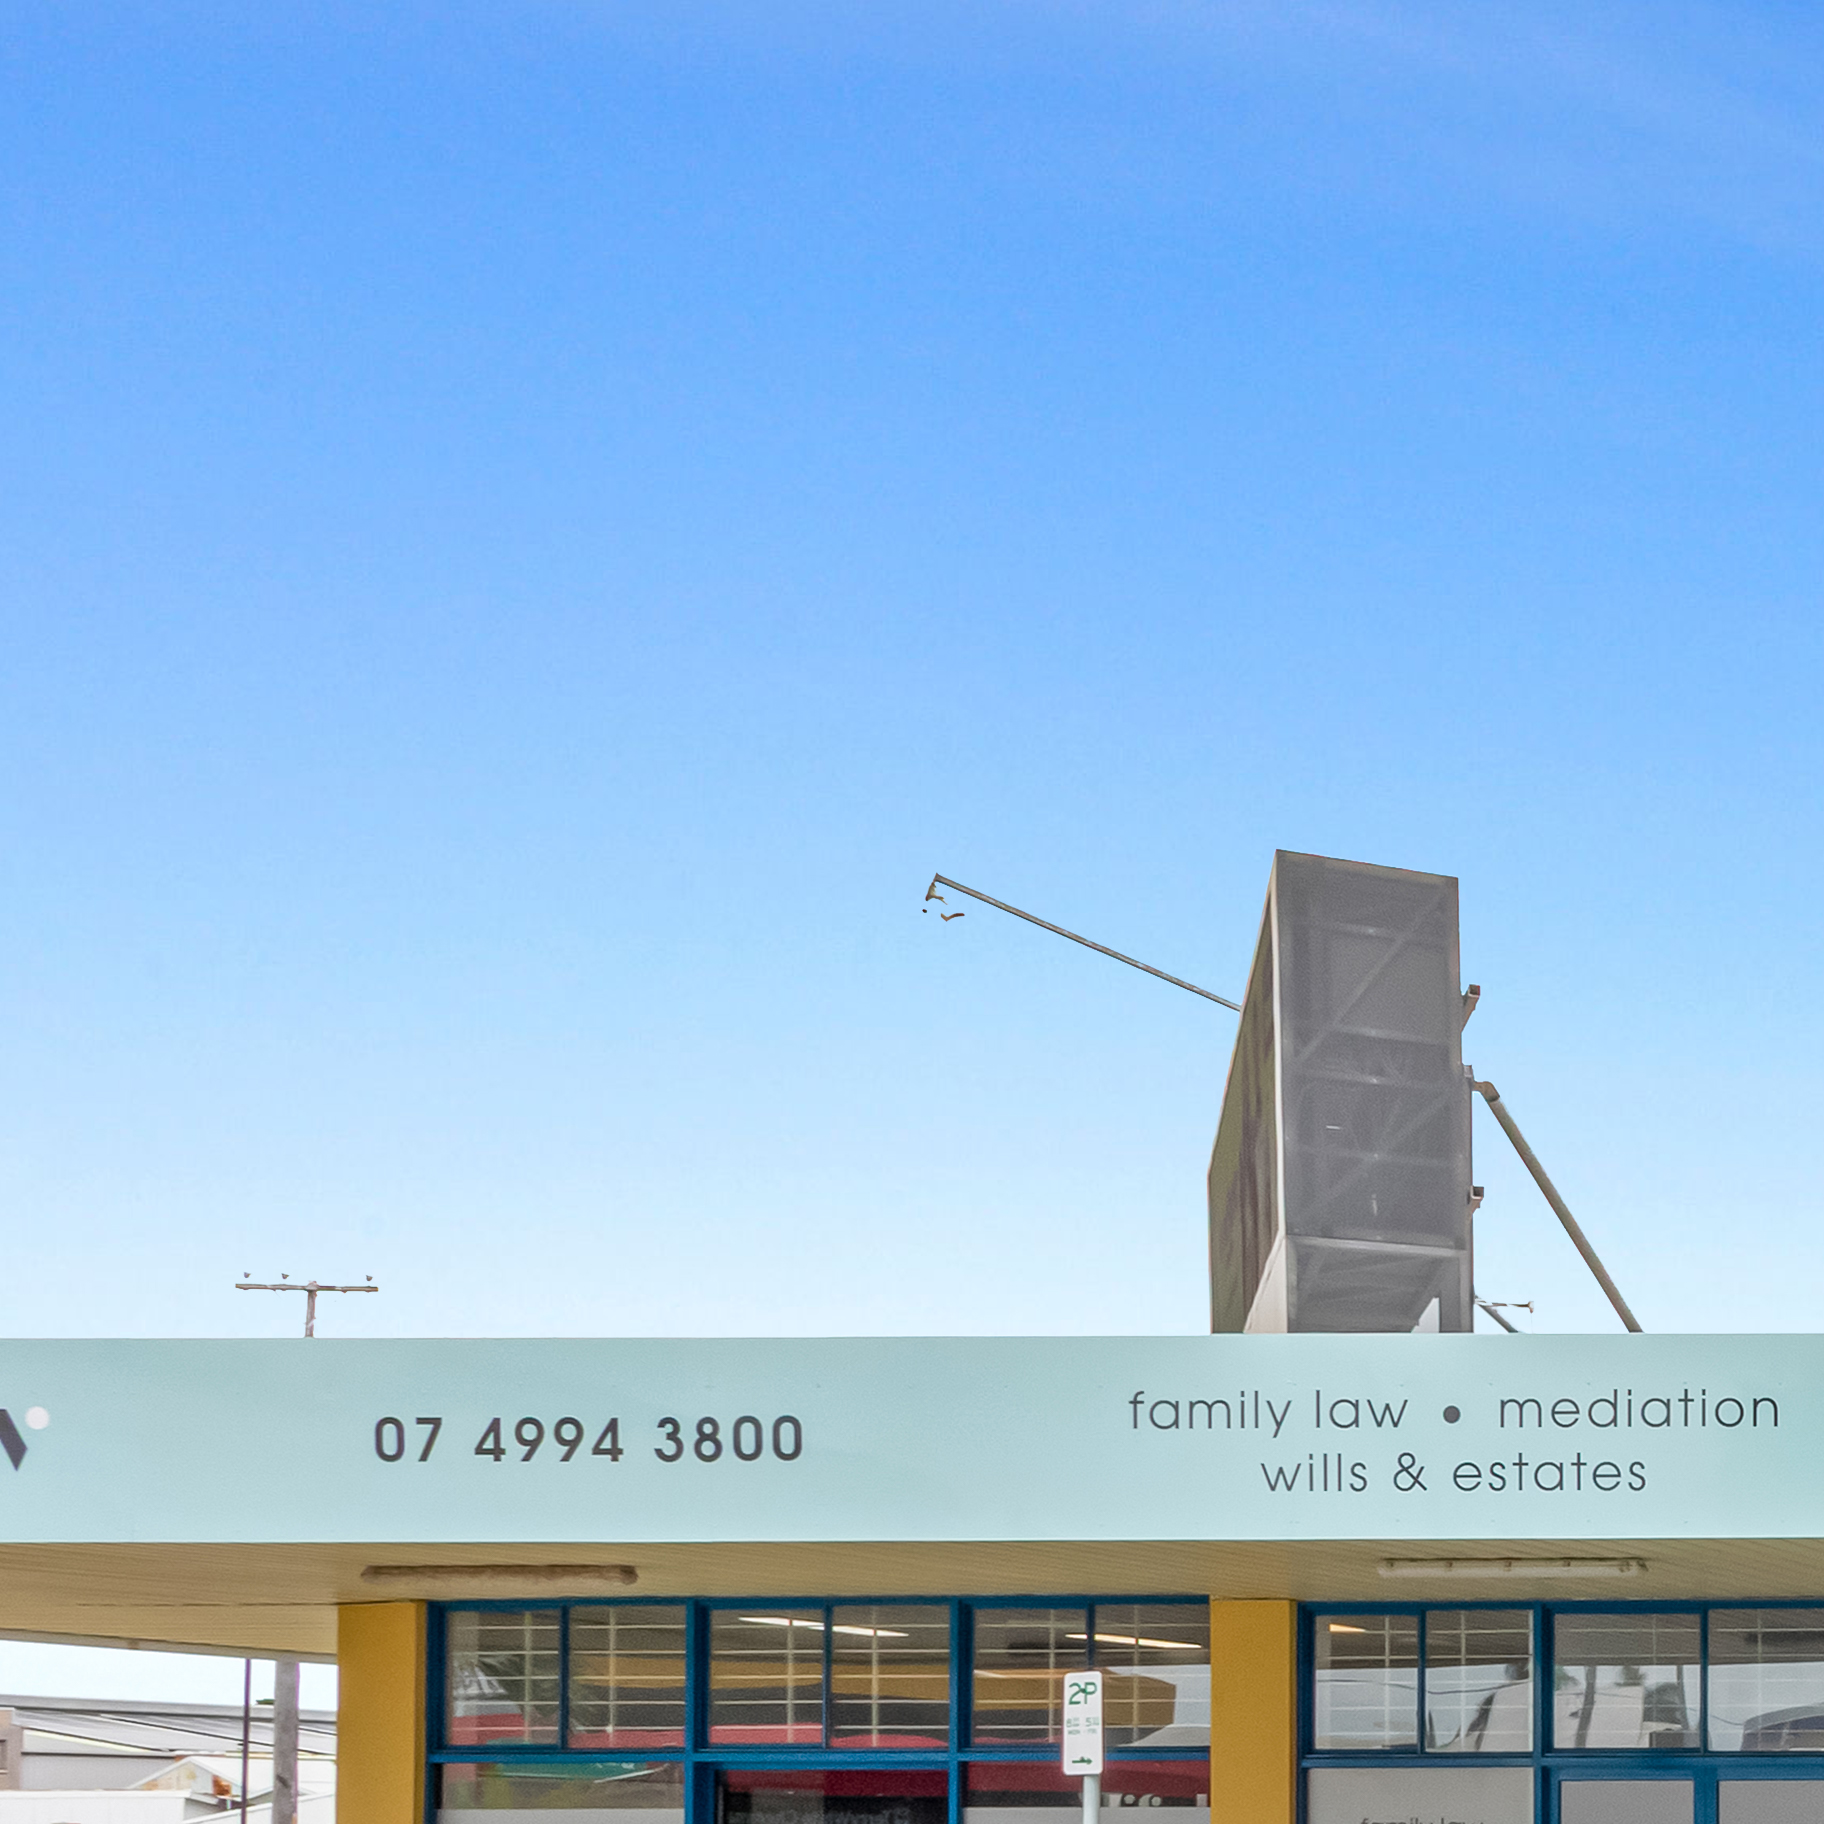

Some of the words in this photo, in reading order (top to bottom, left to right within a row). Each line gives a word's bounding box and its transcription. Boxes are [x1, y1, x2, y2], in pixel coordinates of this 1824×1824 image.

[1127, 1390, 1293, 1439] family
[1315, 1389, 1409, 1430] law
[1499, 1388, 1779, 1430] mediation
[374, 1416, 443, 1463] 07
[473, 1416, 624, 1463] 4994
[653, 1415, 803, 1463] 3800
[1260, 1452, 1368, 1493] wills
[1392, 1451, 1428, 1492] &
[1452, 1451, 1647, 1492] estates
[1068, 1681, 1098, 1706] 2P
